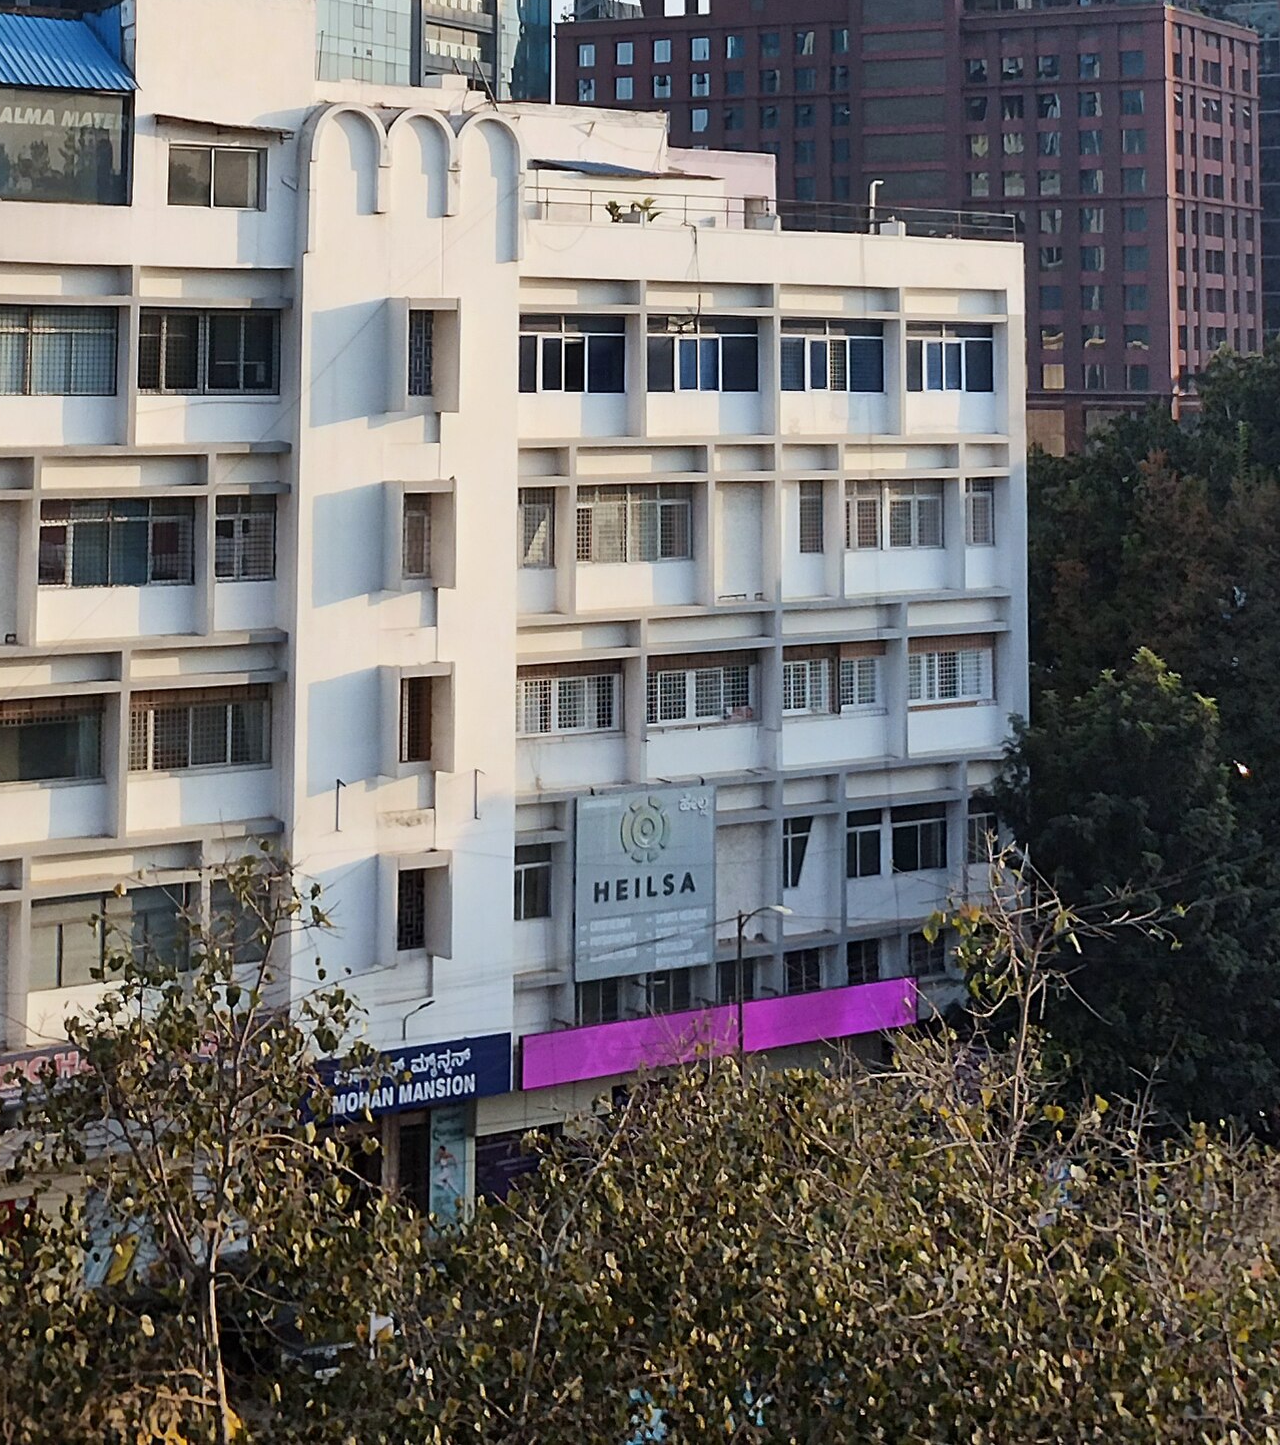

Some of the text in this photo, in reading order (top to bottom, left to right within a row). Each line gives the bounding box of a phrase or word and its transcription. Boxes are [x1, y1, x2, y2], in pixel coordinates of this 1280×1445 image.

[593, 872, 696, 904] HEILSA
[332, 1073, 476, 1114] MOHAN MANSION
